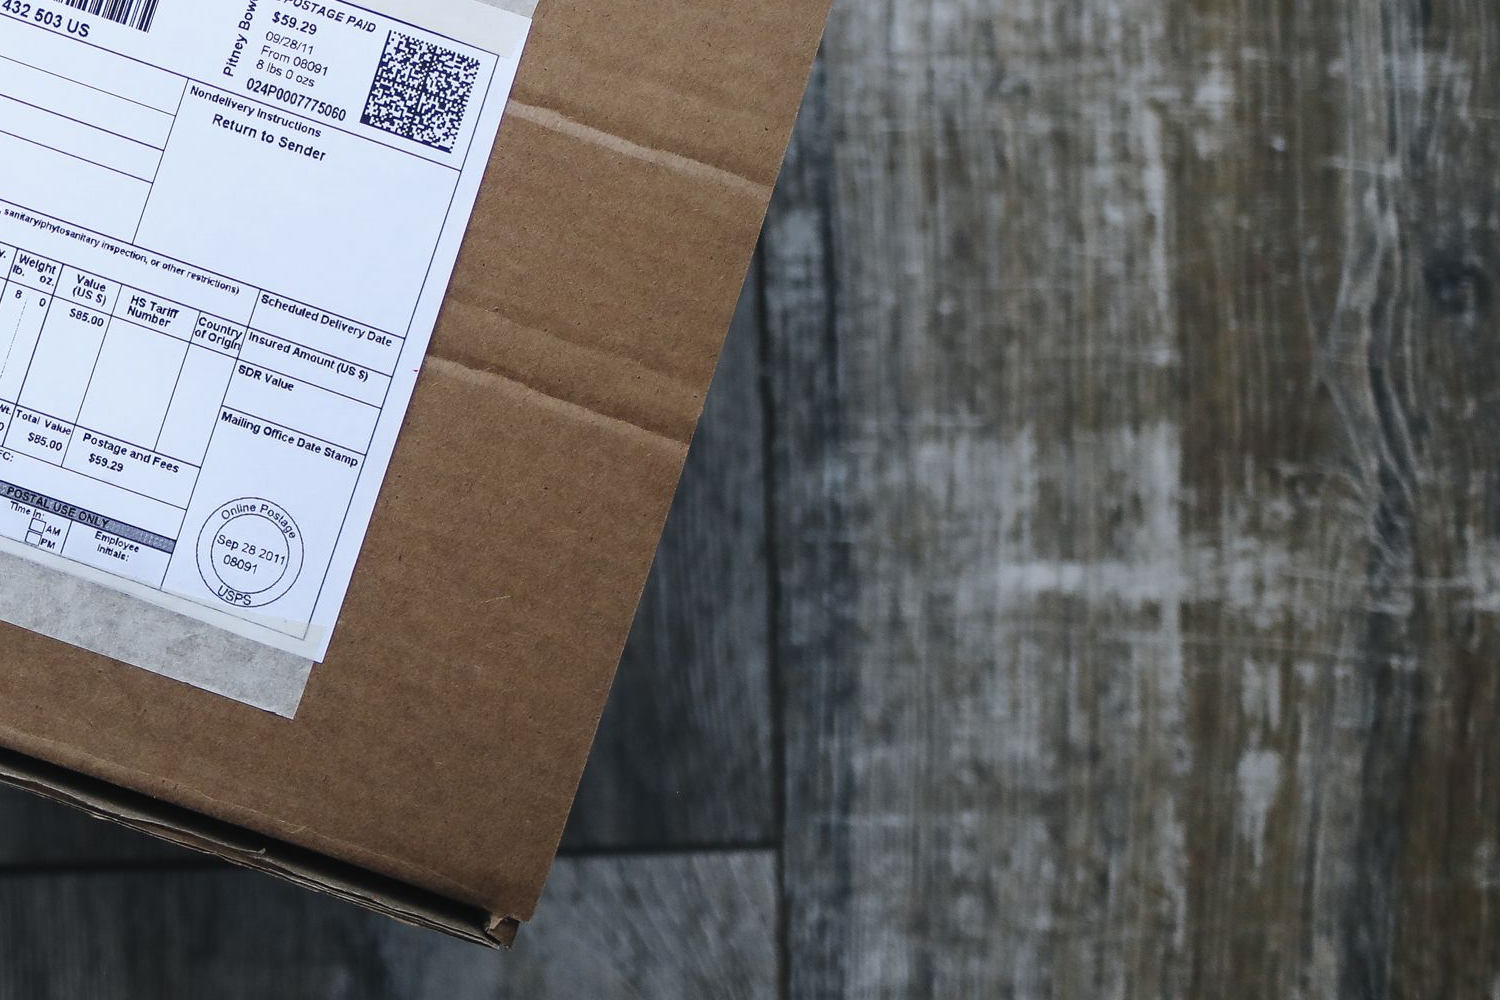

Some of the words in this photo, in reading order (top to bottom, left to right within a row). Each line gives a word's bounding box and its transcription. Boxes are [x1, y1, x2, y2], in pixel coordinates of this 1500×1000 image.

[33, 7, 63, 29] 503
[66, 17, 91, 38] US
[271, 10, 318, 36] $59.29
[345, 15, 377, 33] PAID
[222, 33, 248, 78] Pitney
[265, 30, 314, 56] 09/28/11
[255, 58, 265, 70] 8
[266, 61, 283, 77] lbs
[284, 68, 295, 80] 0
[295, 74, 316, 88] ozs
[260, 44, 291, 64] From
[292, 55, 329, 77] 08091
[189, 84, 256, 117] Nondelivery
[256, 107, 322, 138] Instructions
[246, 77, 347, 122] 024P0007775060
[211, 113, 258, 139] Return
[260, 130, 275, 144] to
[277, 135, 327, 162] Sender
[18, 253, 57, 276] Weight
[39, 275, 55, 287] oz.
[76, 273, 107, 293] Value
[14, 289, 23, 300] 8
[38, 297, 47, 308] 0
[129, 294, 147, 309] HS
[149, 300, 180, 319] Tariff
[68, 307, 105, 328] $85.00
[126, 304, 172, 328] Number
[198, 316, 244, 341] Country
[260, 293, 320, 323] Scheduled
[319, 313, 366, 340] Delivery
[366, 330, 393, 348] Date
[194, 329, 208, 339] of
[207, 332, 242, 352] Origin
[247, 331, 292, 354] Insured
[291, 346, 336, 370] Amount
[237, 364, 263, 381] SDR
[264, 372, 295, 392] Value
[15, 408, 41, 425] Total
[44, 418, 72, 436] Value
[27, 431, 63, 452] $85.00
[220, 410, 262, 435] Mailing
[262, 425, 296, 445] Office
[296, 437, 322, 454] Date
[323, 446, 359, 468] Stamp
[82, 431, 128, 456] Postage
[129, 450, 152, 464] and
[151, 455, 180, 474] Fees
[88, 452, 124, 473] $59.29
[6, 486, 50, 510] POSTAL
[53, 501, 77, 518] USE
[78, 510, 110, 529] ONLY
[10, 500, 32, 516] Time
[32, 508, 45, 522] In:
[44, 525, 62, 537] AM
[220, 503, 257, 521] Online
[259, 503, 297, 539] Postage
[39, 536, 57, 550] PM
[216, 533, 240, 551] Sep
[240, 542, 257, 556] 28
[257, 548, 286, 566] 2011
[222, 553, 258, 575] 08091
[217, 583, 254, 607] USPS
